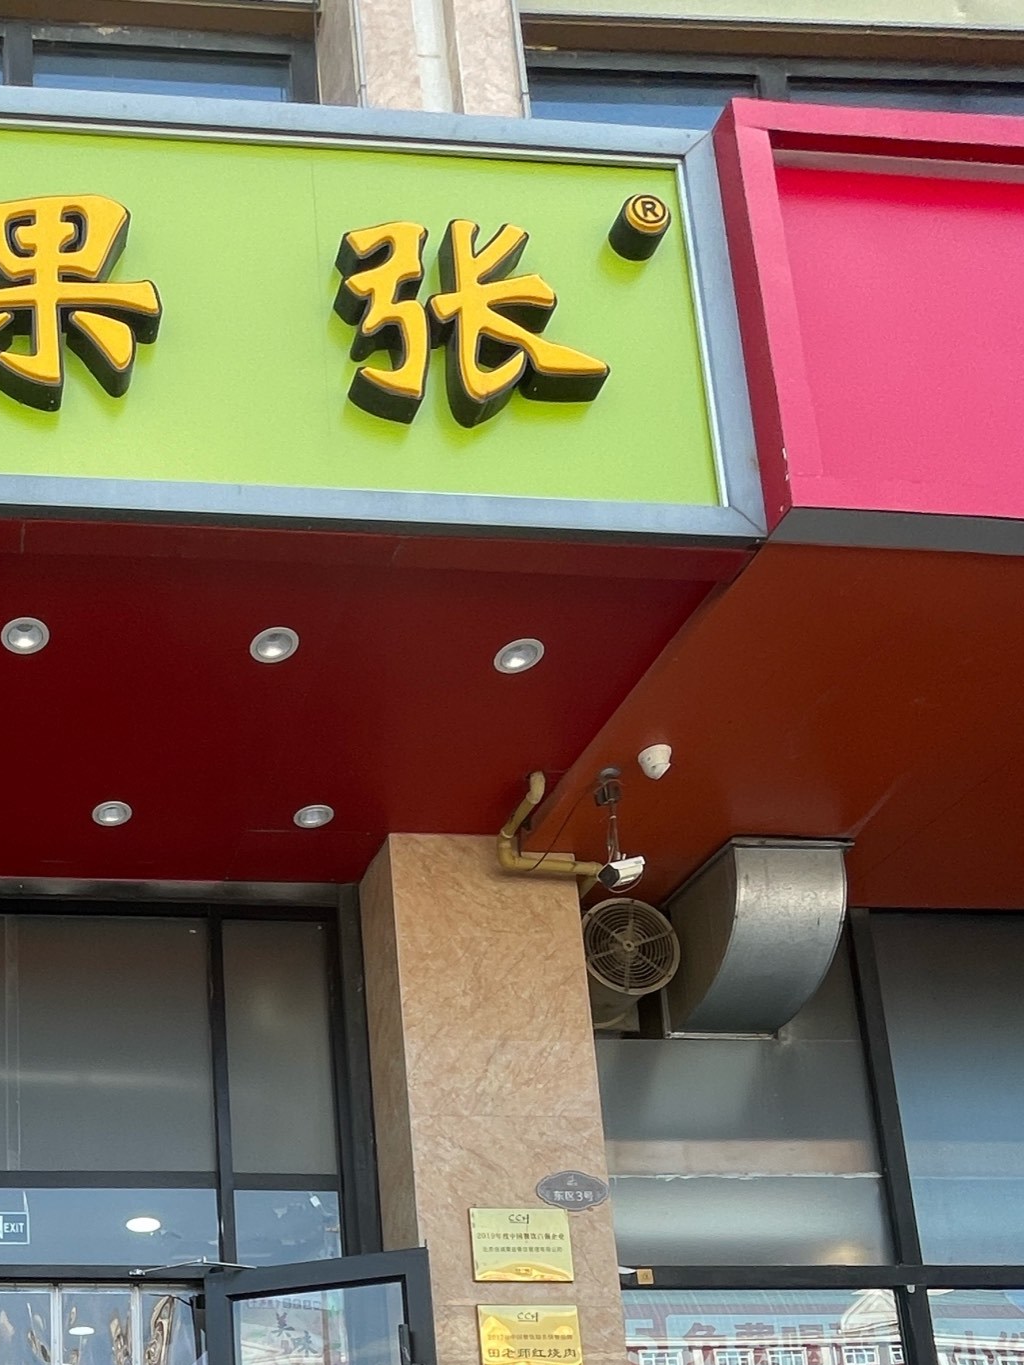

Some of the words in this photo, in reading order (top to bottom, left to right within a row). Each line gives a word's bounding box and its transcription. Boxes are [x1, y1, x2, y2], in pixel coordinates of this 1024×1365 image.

[553, 1190, 593, 1201] 东区3号
[3, 1222, 25, 1233] EXIT
[488, 1348, 576, 1358] 田老师红烧肉
